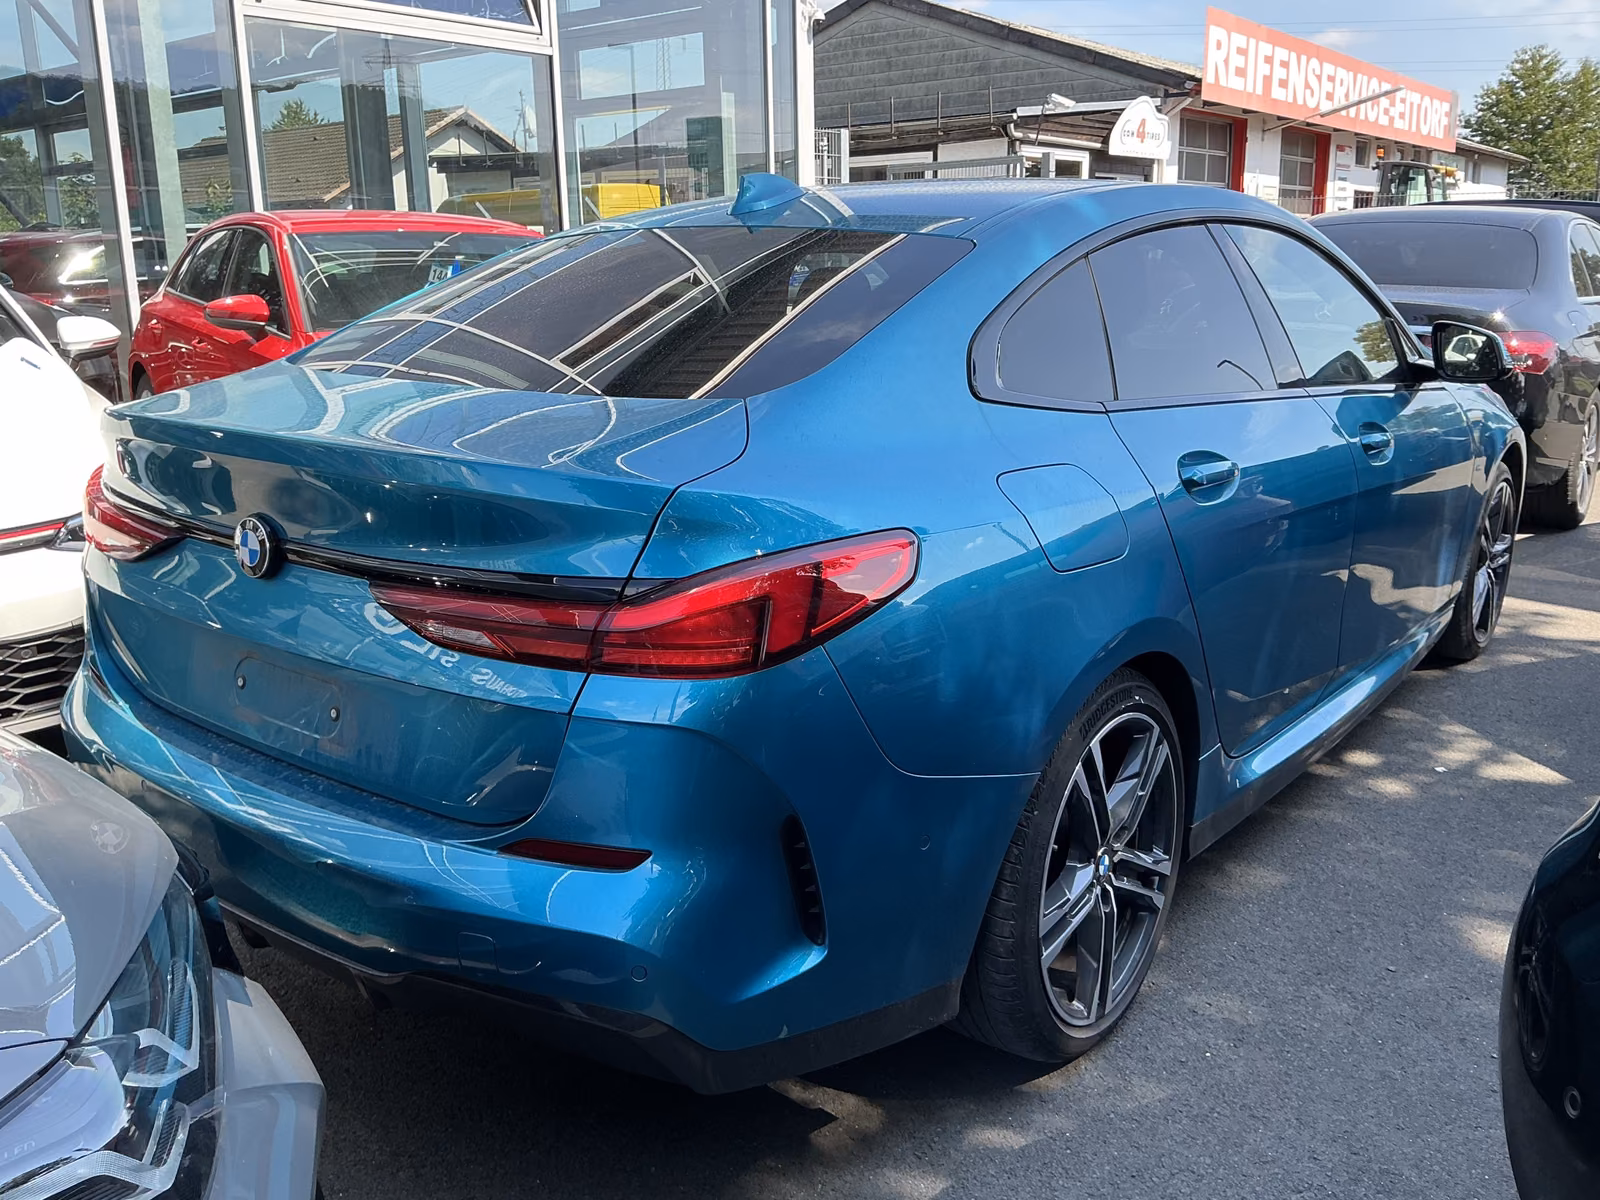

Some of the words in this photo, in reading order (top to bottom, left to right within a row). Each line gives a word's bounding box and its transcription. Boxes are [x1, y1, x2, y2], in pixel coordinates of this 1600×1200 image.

[1206, 24, 1450, 139] REIFENSERVICE-EITORF
[1136, 118, 1146, 144] 4
[1079, 687, 1133, 740] BRIDGESTONE
